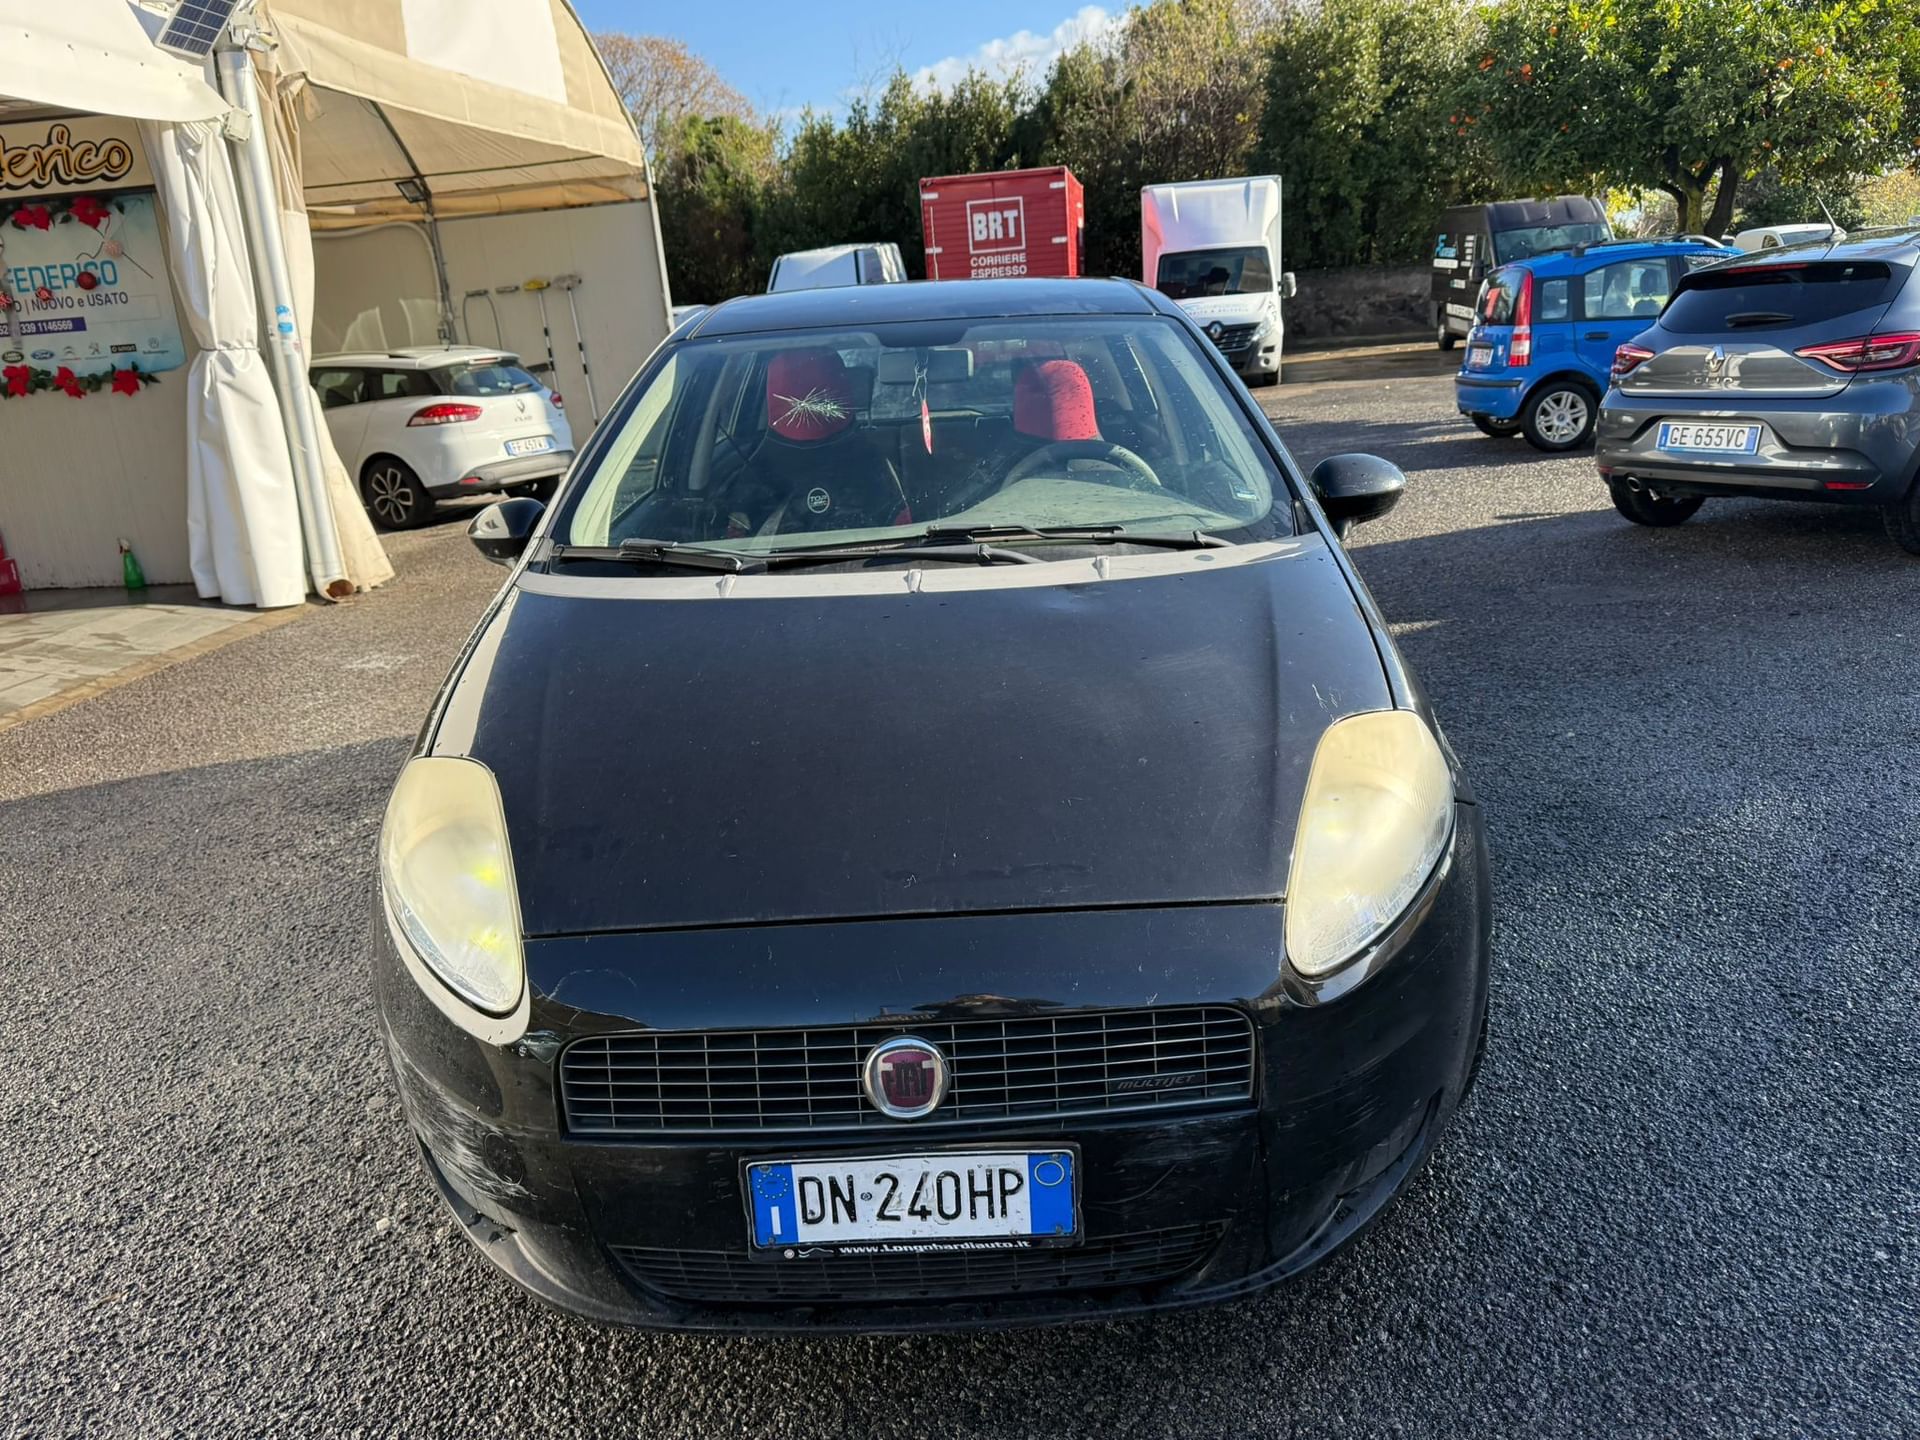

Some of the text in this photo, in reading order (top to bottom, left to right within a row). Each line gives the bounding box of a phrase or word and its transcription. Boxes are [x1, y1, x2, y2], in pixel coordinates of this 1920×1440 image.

[972, 209, 1019, 242] BRT
[970, 252, 1027, 267] CORRIERE
[971, 264, 1028, 278] ESPRESSO
[86, 291, 129, 307] USATO
[20, 322, 37, 334] 339
[1670, 427, 1690, 446] GE
[1694, 428, 1746, 448] 655VC
[1117, 1074, 1197, 1090] MULTIJET
[797, 1173, 858, 1226] DN
[873, 1167, 1025, 1223] 240HP
